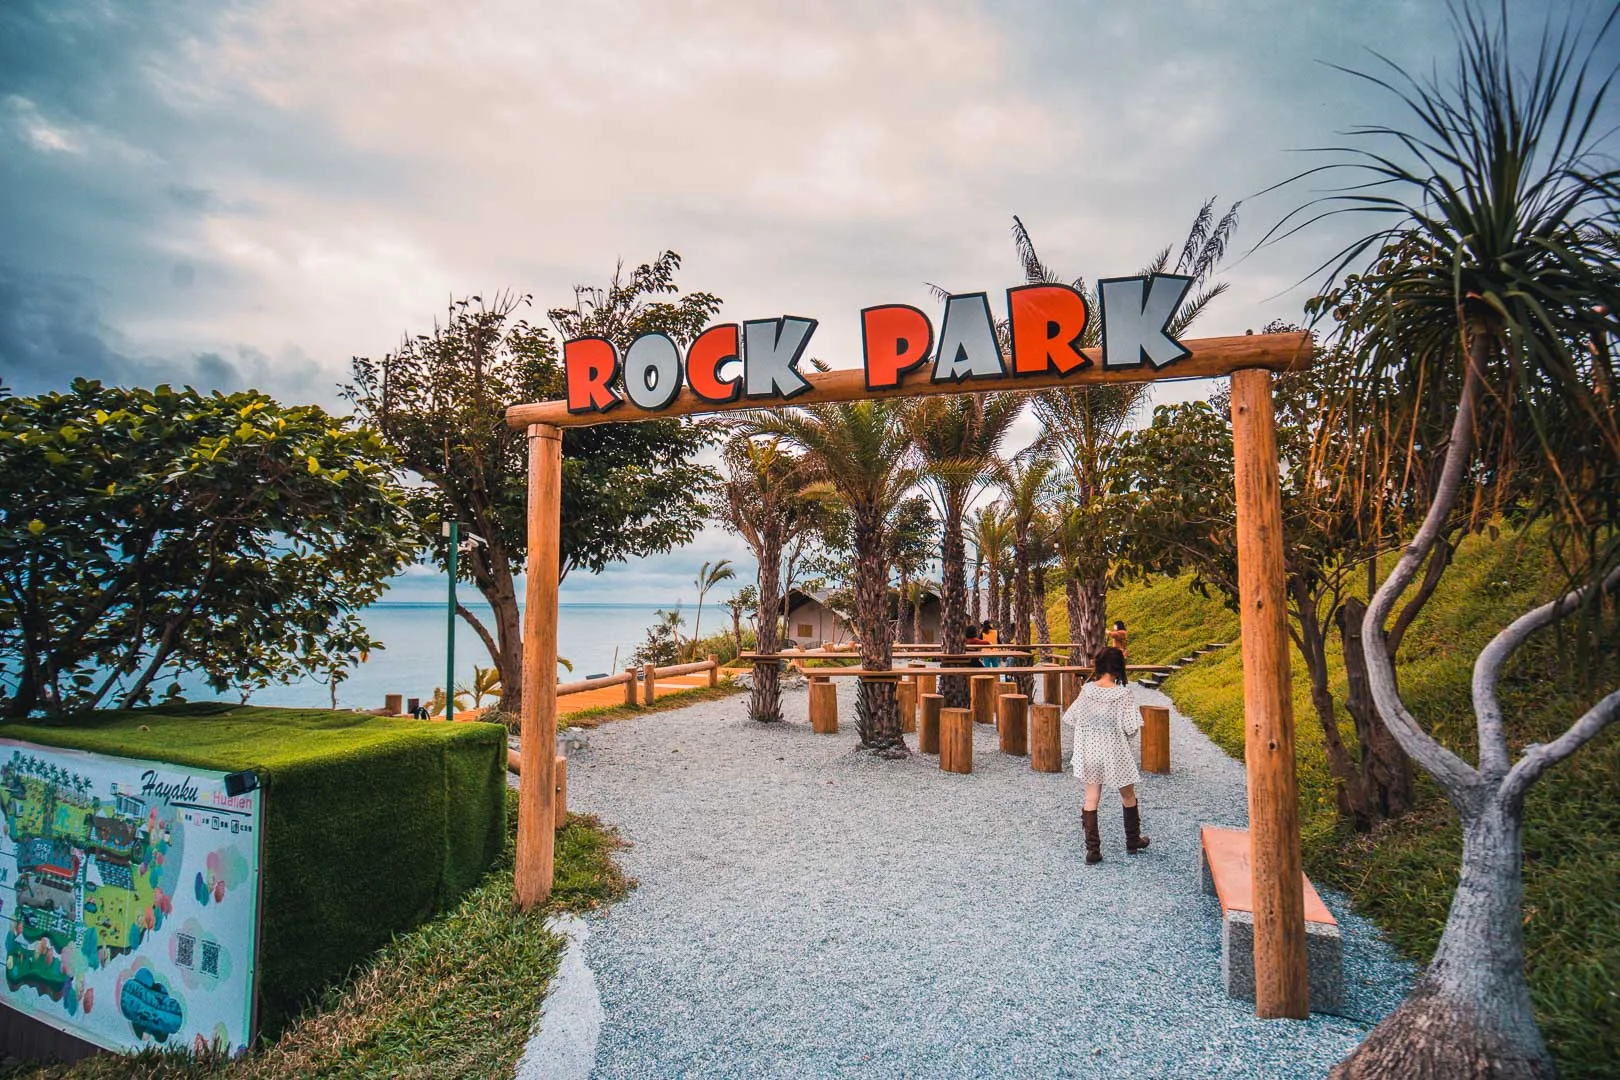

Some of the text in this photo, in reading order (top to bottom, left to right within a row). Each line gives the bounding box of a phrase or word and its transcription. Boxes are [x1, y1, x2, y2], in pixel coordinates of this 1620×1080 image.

[563, 273, 1194, 414] ROCK PARK
[141, 770, 198, 806] Hayaku
[213, 791, 252, 809] Hualien
